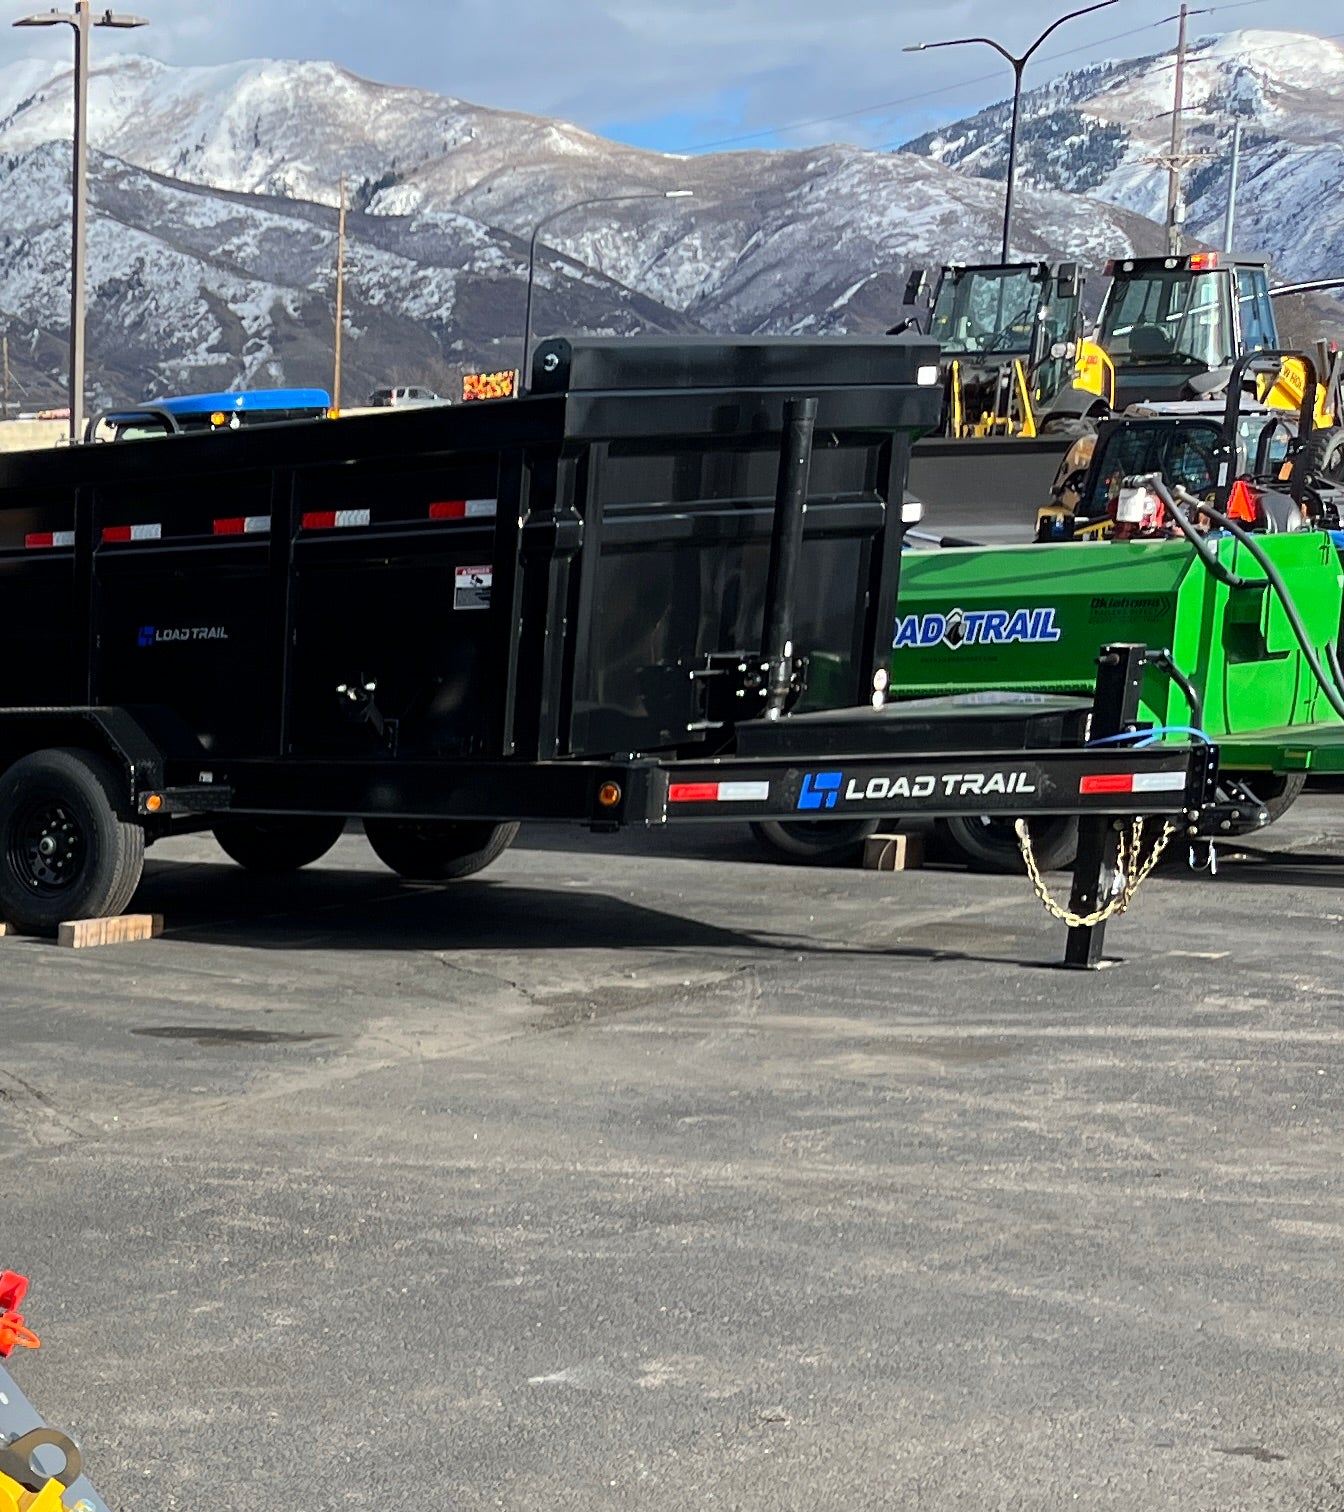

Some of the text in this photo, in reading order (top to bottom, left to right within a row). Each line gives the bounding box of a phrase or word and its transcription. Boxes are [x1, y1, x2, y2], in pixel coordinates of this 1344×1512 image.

[155, 626, 229, 641] LOAD TRAIL
[893, 608, 1060, 648] AD TRAIL
[846, 776, 936, 800] LOAD
[941, 772, 1036, 796] TRAIL
